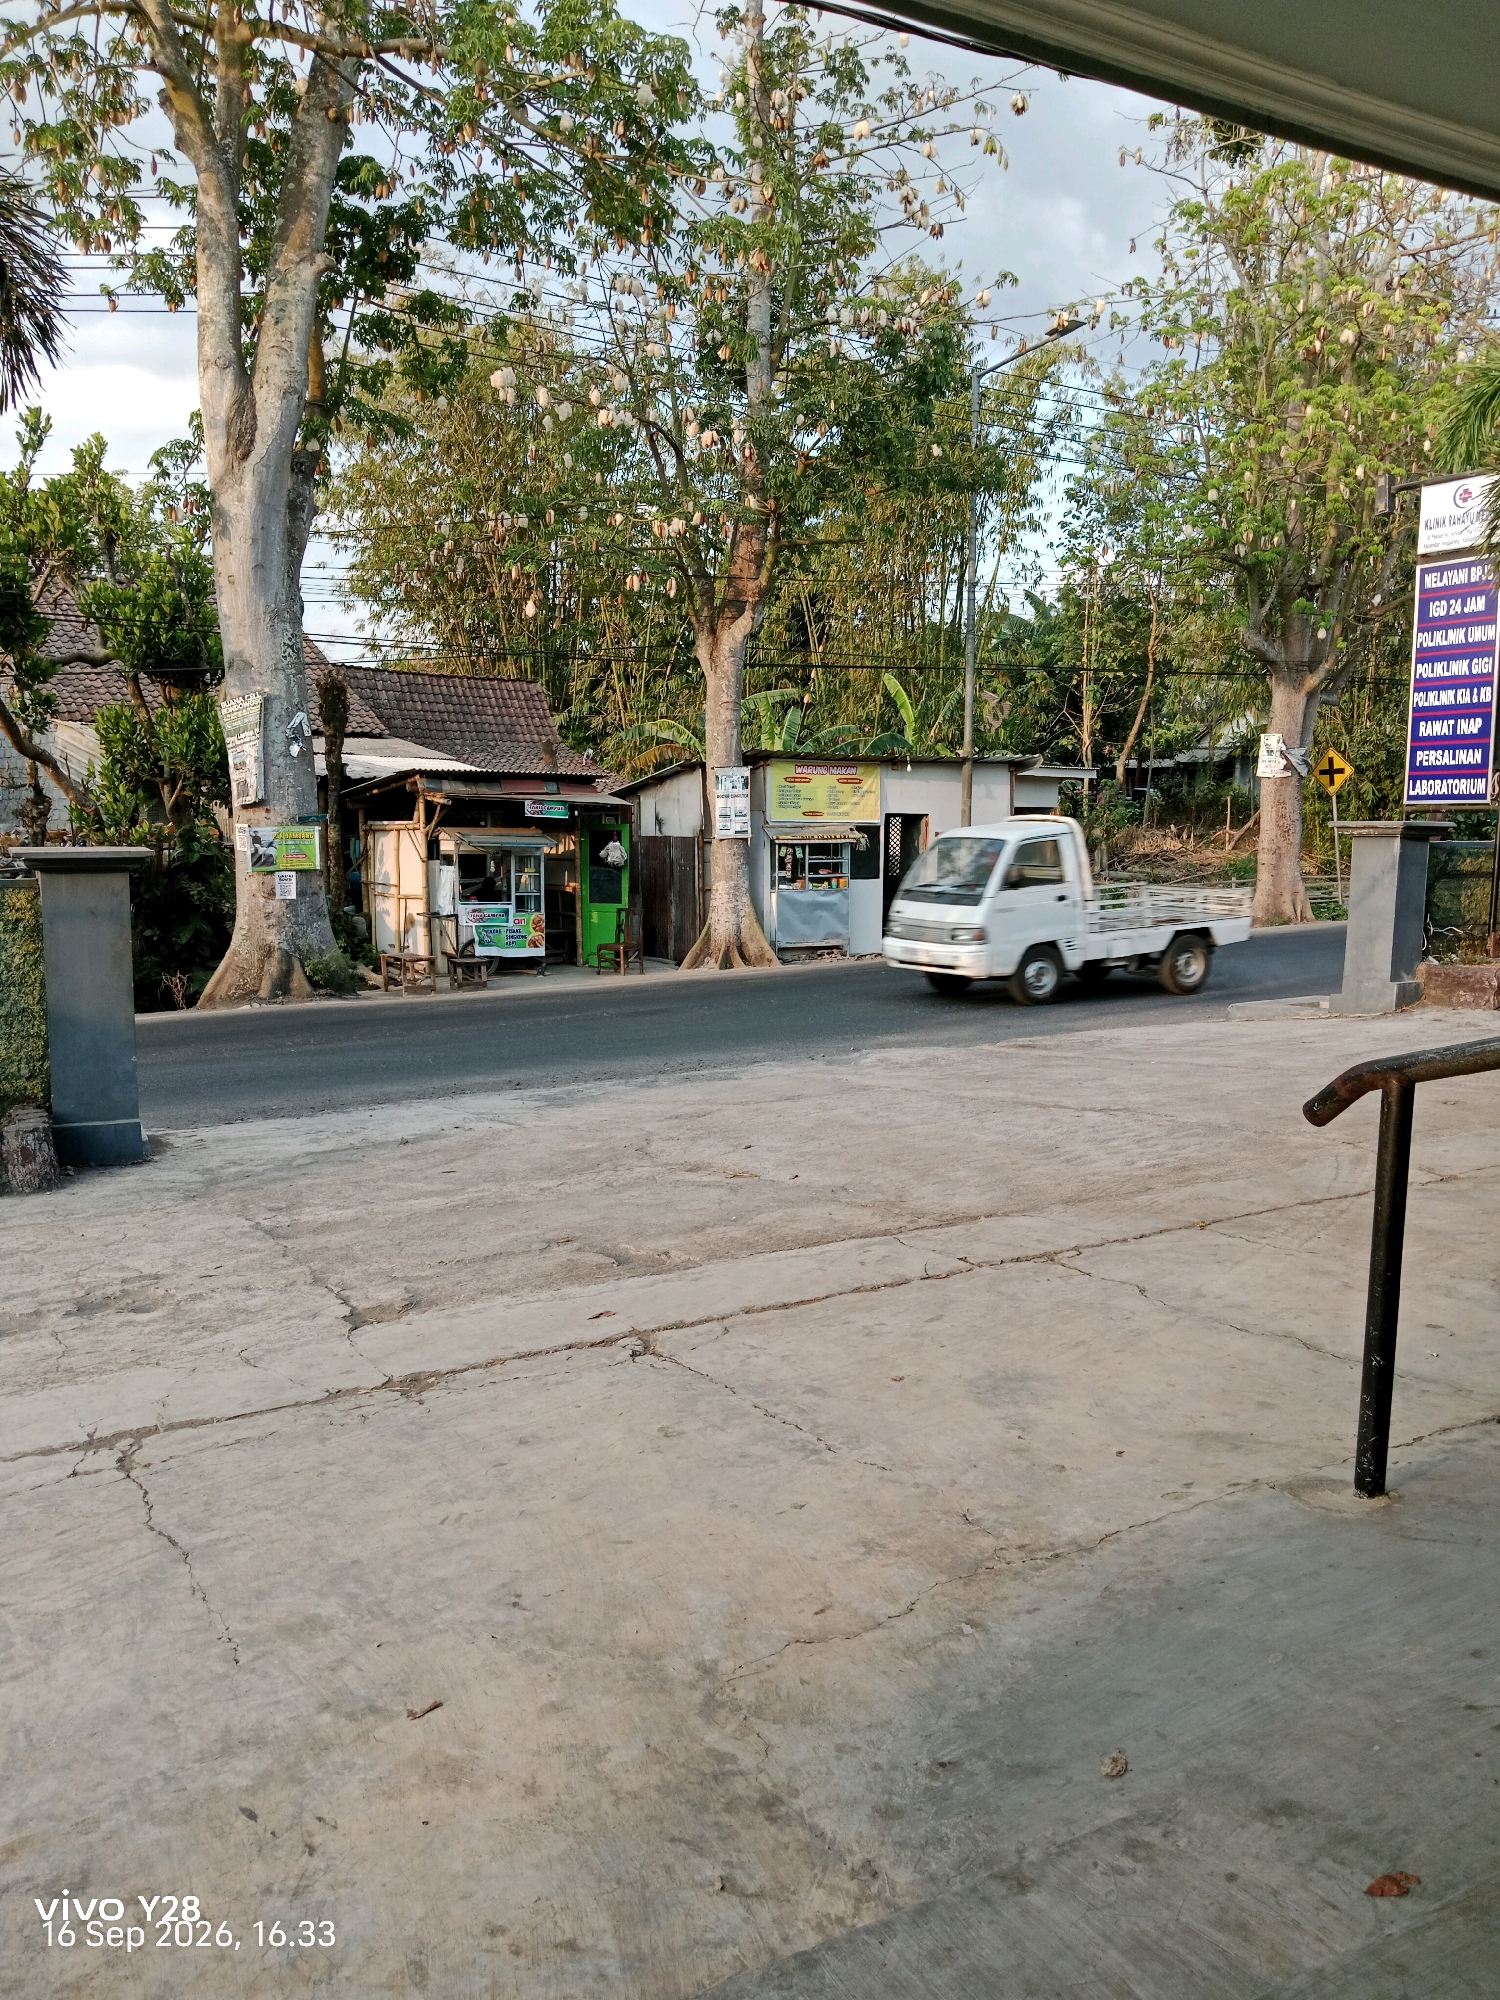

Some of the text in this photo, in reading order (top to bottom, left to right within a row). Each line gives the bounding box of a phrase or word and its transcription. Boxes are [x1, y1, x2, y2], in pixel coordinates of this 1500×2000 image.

[1425, 515, 1447, 531] KLINIK
[1424, 568, 1469, 589] MELAYANI
[1429, 595, 1486, 618] IGD 24 JAM
[1417, 624, 1496, 649] POLIKLINIK UMUM
[1416, 656, 1493, 679] POLIKLINIK GIGI
[1413, 686, 1492, 708] POLIKLINIK KIA & KB
[1419, 717, 1482, 737] RAWAT INAP
[1416, 748, 1482, 767] PERSALINAN
[795, 764, 857, 776] WARUNG MAKAN
[1408, 778, 1486, 796] LABORATORIUM
